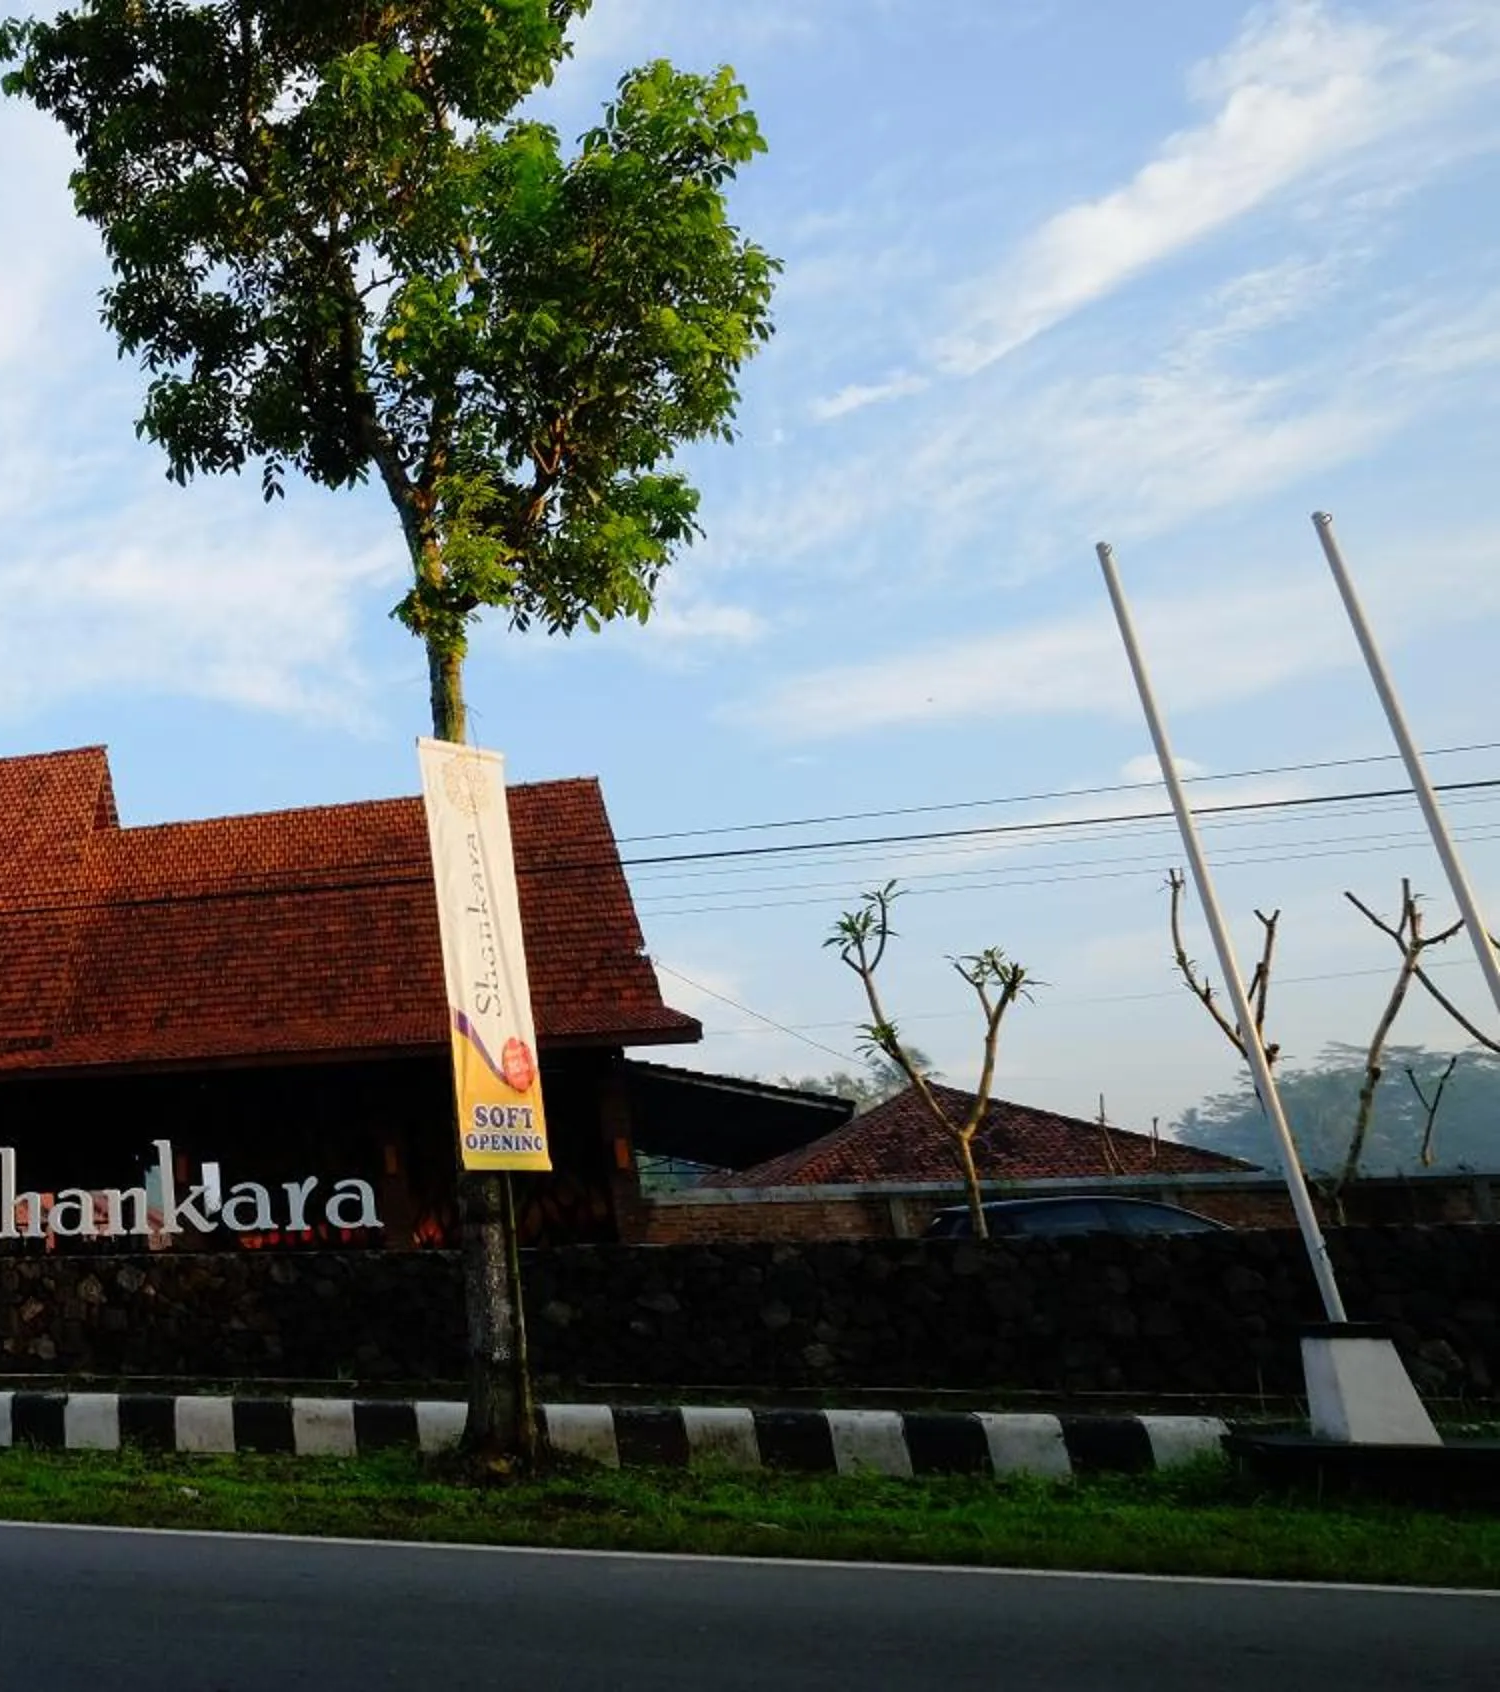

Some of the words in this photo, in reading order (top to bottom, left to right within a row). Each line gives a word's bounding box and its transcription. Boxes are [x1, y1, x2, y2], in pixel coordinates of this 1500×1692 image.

[467, 833, 501, 1017] Shankara
[473, 1104, 533, 1129] SOFT
[464, 1132, 544, 1151] OPENING
